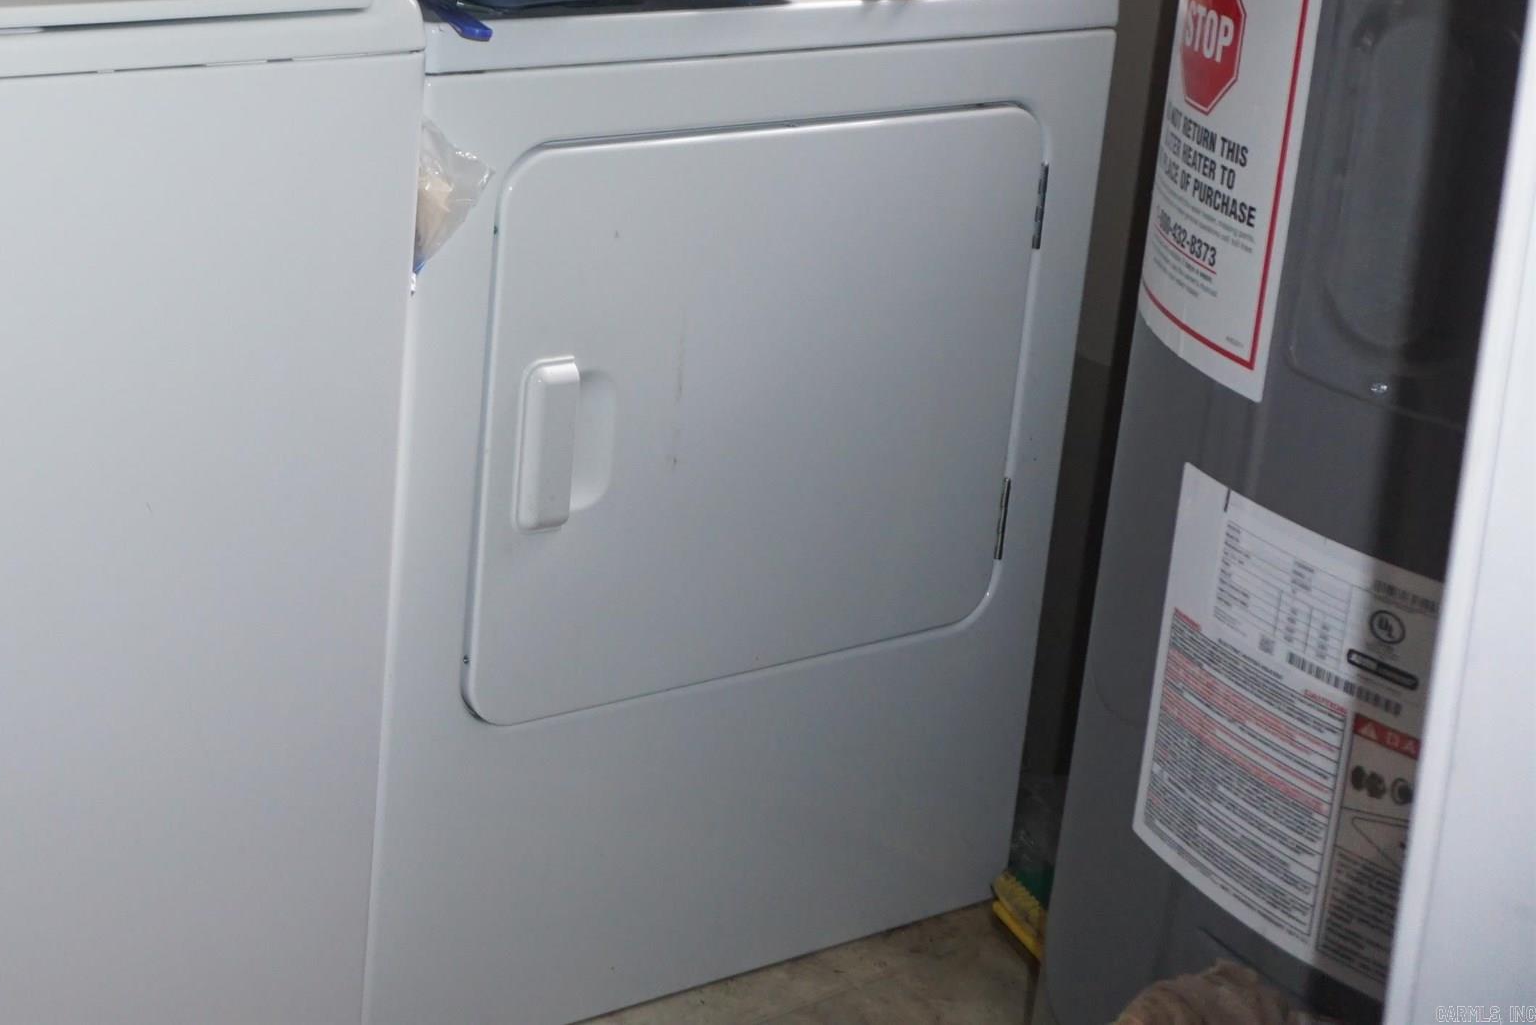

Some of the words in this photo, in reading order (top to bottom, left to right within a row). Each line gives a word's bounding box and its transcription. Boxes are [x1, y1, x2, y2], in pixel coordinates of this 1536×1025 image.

[1184, 0, 1234, 63] STOP
[1182, 115, 1217, 153] RETURN
[1220, 136, 1249, 167] THIS
[1182, 143, 1217, 181] HEATER
[1220, 165, 1236, 190] TO
[1180, 168, 1192, 191] OF
[1192, 178, 1257, 228] PURCHASE
